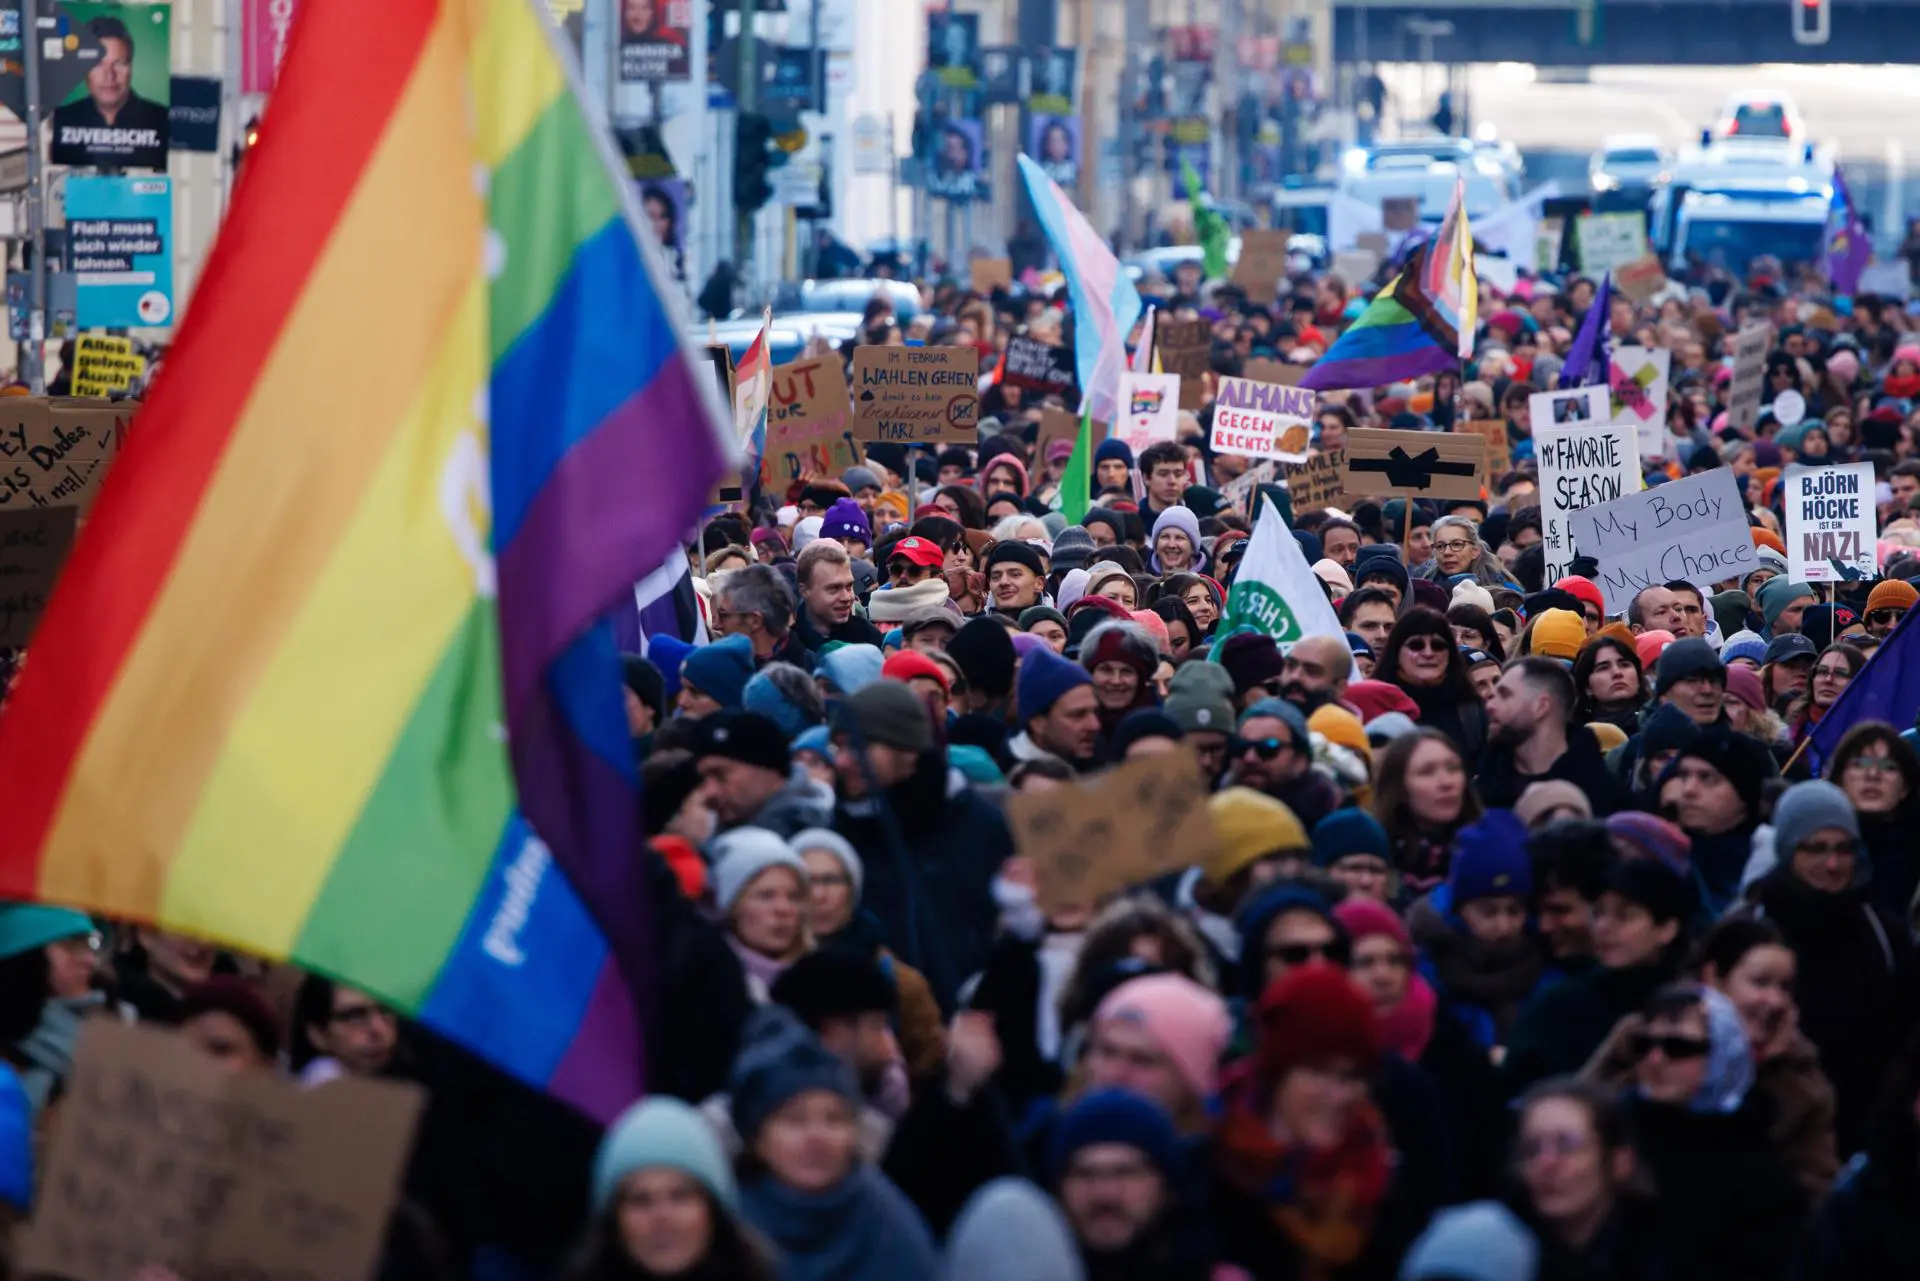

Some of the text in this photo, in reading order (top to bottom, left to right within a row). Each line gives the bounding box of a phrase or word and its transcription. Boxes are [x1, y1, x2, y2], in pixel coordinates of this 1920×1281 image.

[888, 352, 948, 364] IM FEBRUAR
[767, 362, 822, 406] UT
[1217, 380, 1314, 420] ALMANS
[1218, 410, 1274, 434] GEGEN
[1215, 431, 1271, 452] RECHTS
[1541, 443, 1555, 468] MY
[1556, 434, 1622, 471] FAVORITE
[1554, 472, 1622, 510] SEASON
[1802, 471, 1859, 496] BJÖRN
[1593, 511, 1637, 546] My
[1646, 487, 1722, 529] Body
[1802, 496, 1860, 520] HÖCKE
[1549, 519, 1557, 535] IS
[1819, 521, 1843, 530] IST EIN
[1545, 535, 1560, 550] THE
[1803, 531, 1860, 562] NAZI
[1546, 560, 1575, 587] DAT
[1603, 543, 1752, 603] My Choice
